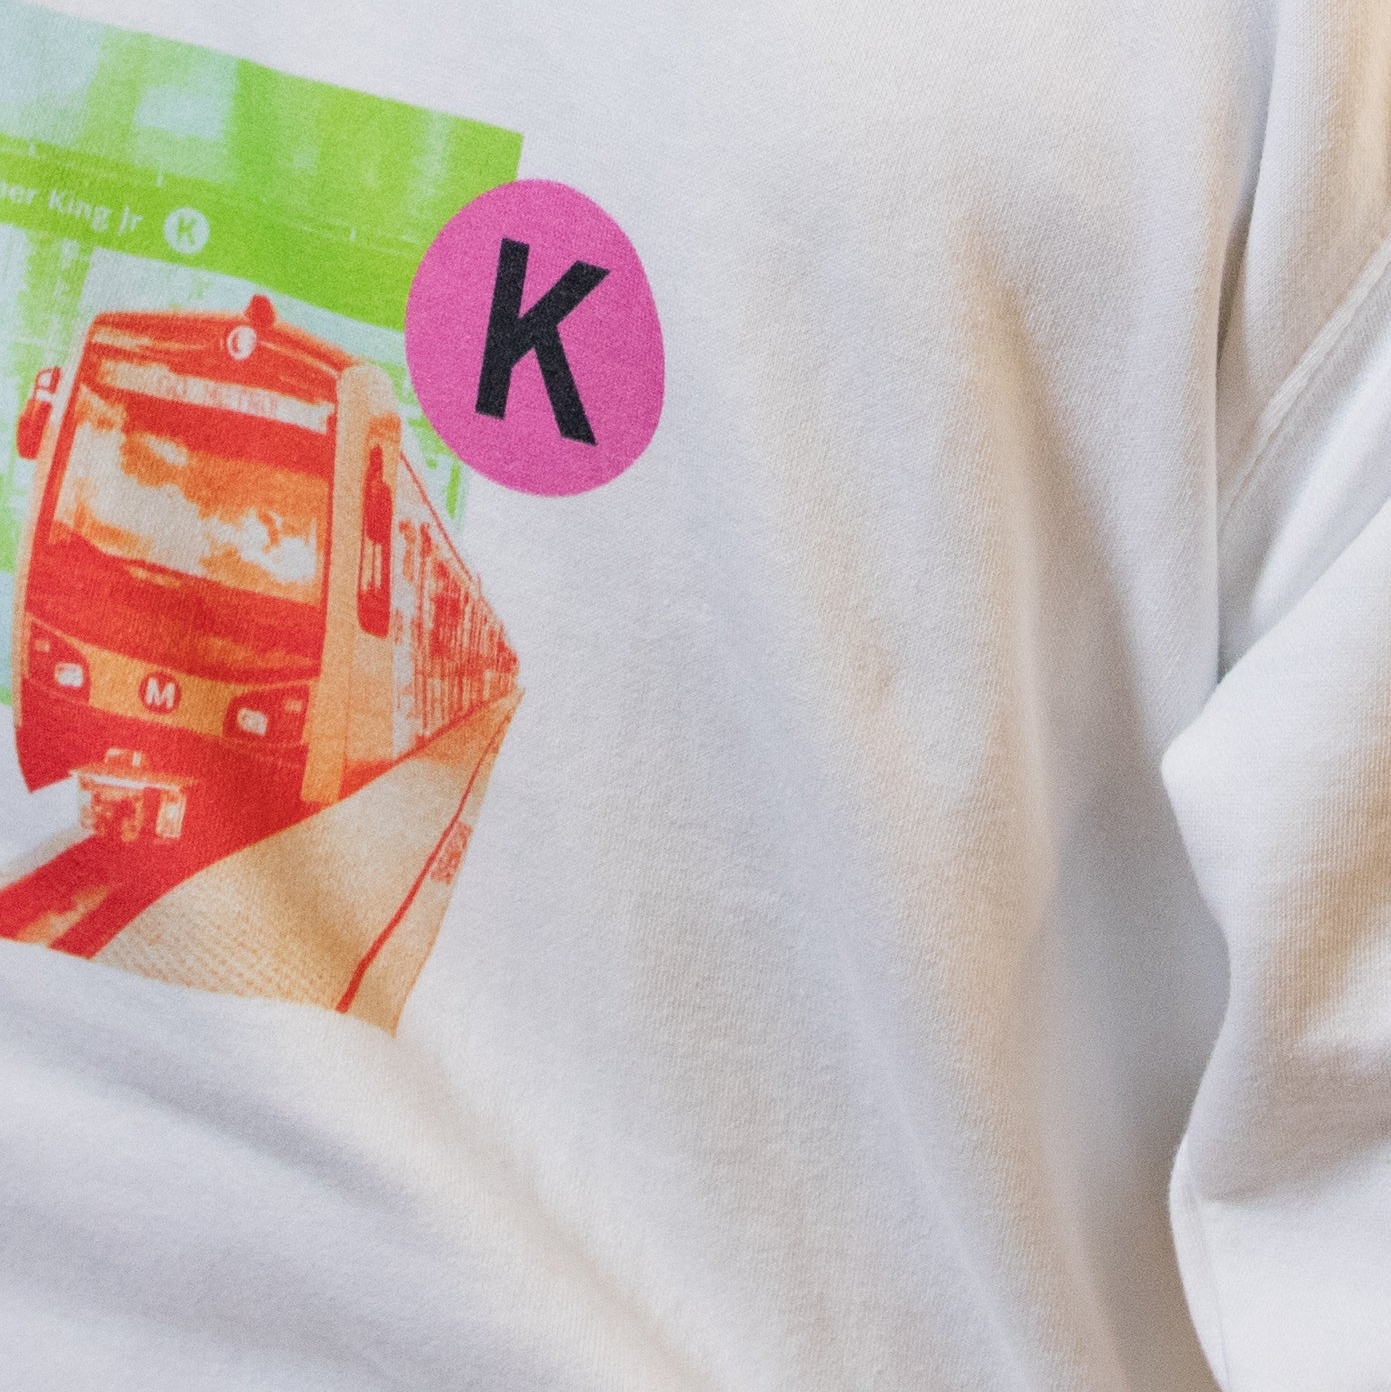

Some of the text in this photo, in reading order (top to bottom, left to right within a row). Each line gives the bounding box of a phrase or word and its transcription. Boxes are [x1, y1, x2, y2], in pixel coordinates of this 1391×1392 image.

[48, 188, 111, 232] King
[475, 237, 610, 447] K
[145, 677, 176, 709] M
